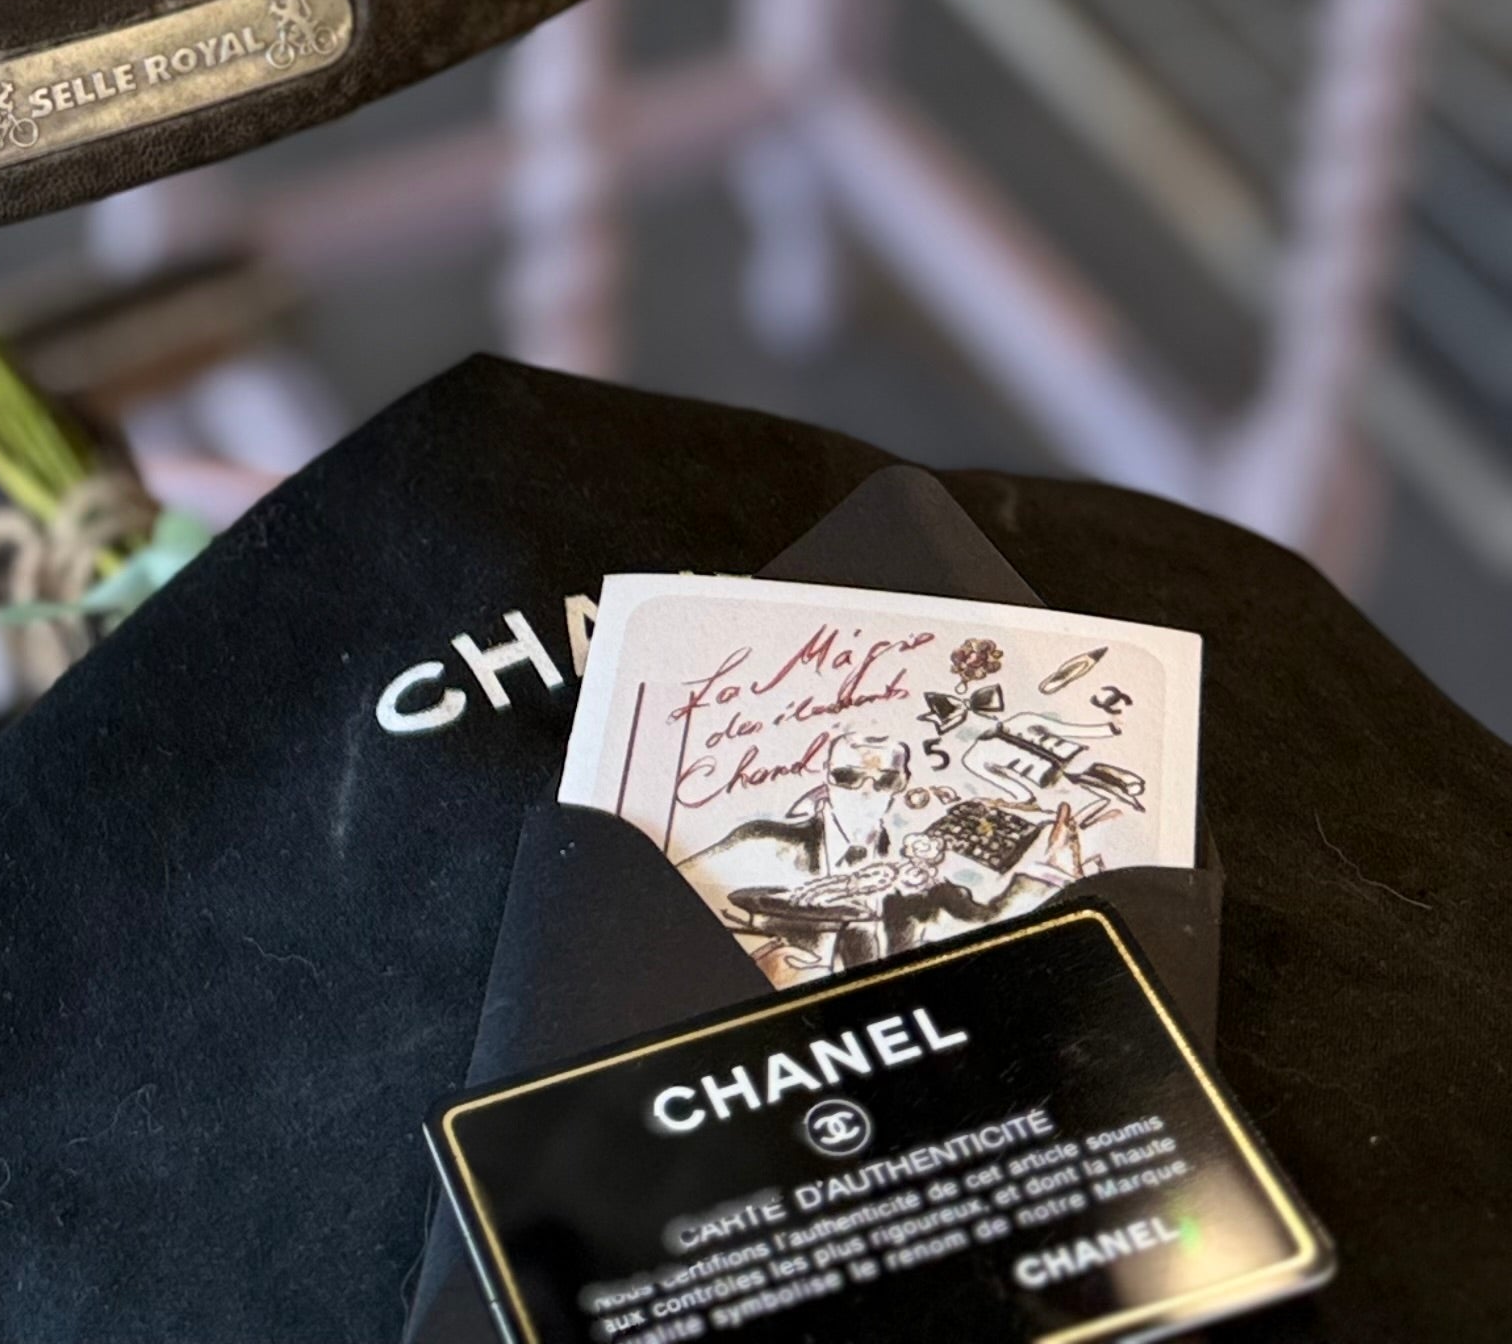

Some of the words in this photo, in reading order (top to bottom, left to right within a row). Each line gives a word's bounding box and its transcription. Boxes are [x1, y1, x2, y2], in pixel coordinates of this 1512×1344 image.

[30, 62, 137, 119] SELLE
[142, 25, 268, 85] ROYAL
[653, 1008, 968, 1132] CHANEL
[601, 1310, 647, 1334] aux
[651, 1267, 767, 1318] contrôles
[769, 1253, 809, 1279] les
[813, 1233, 866, 1269] plus
[992, 1182, 1021, 1207] et
[1024, 1164, 1080, 1198] dont
[1083, 1157, 1109, 1178] la
[1111, 1134, 1178, 1169] haute
[661, 1239, 772, 1290] certifions
[927, 1180, 960, 1203] de
[963, 1164, 1004, 1193] cet
[1008, 1140, 1079, 1177] article
[1085, 1113, 1166, 1151] soumis
[678, 1196, 788, 1248] CARTE
[794, 1108, 1054, 1211] D'AUTHENTICITÉ
[710, 1270, 844, 1330] symbolise
[849, 1258, 881, 1282] le
[885, 1229, 969, 1271] renom
[975, 1215, 1010, 1241] de
[1017, 1190, 1086, 1227] notre
[1014, 1214, 1183, 1288] CHANEL
